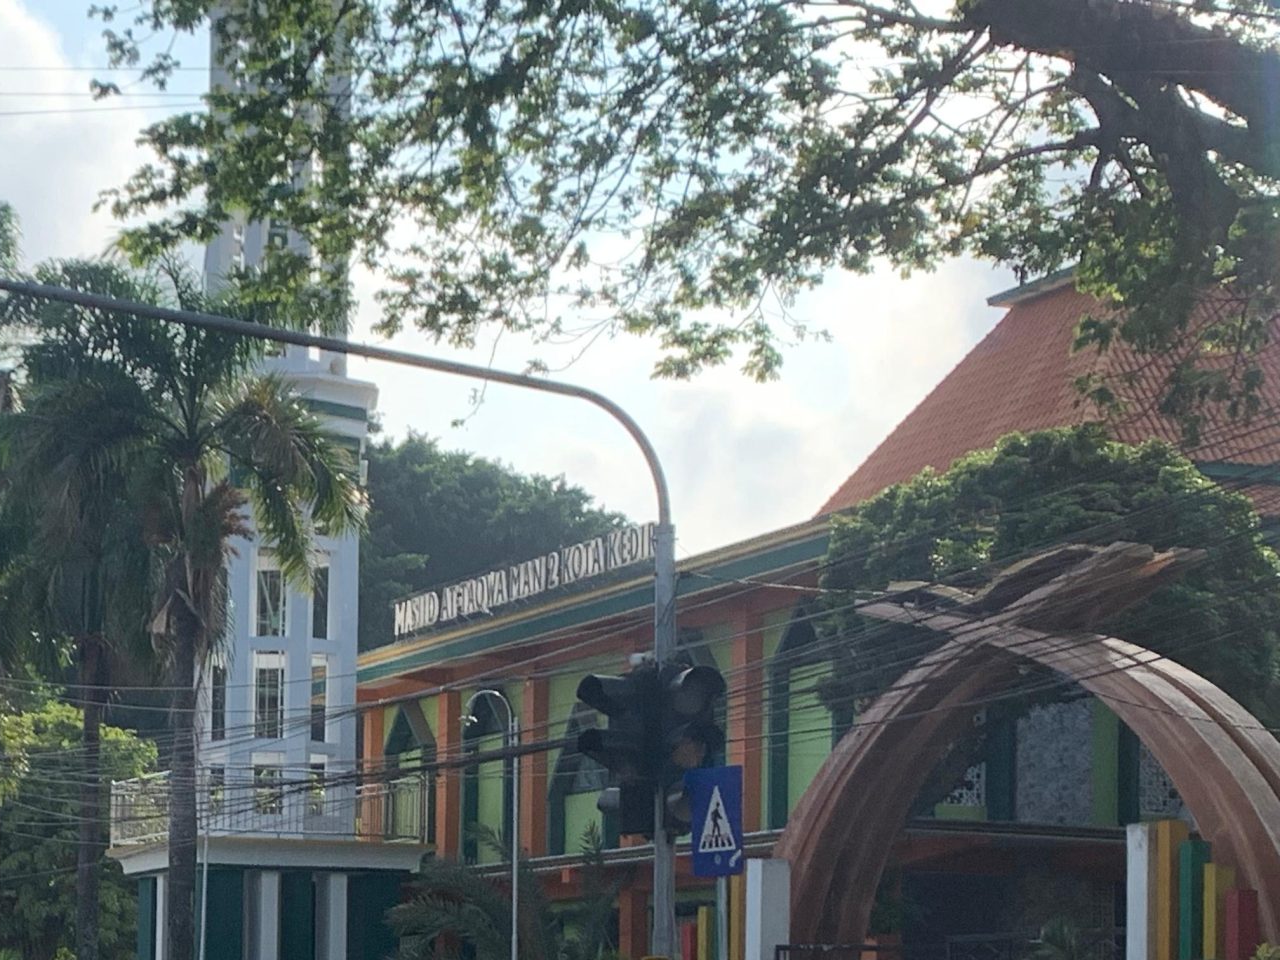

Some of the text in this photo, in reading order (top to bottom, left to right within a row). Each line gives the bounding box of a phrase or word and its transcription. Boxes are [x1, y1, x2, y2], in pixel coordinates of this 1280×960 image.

[509, 556, 546, 601] MAN
[547, 551, 559, 588] 2
[560, 537, 604, 584] KOTA
[606, 521, 657, 570] KEDIR
